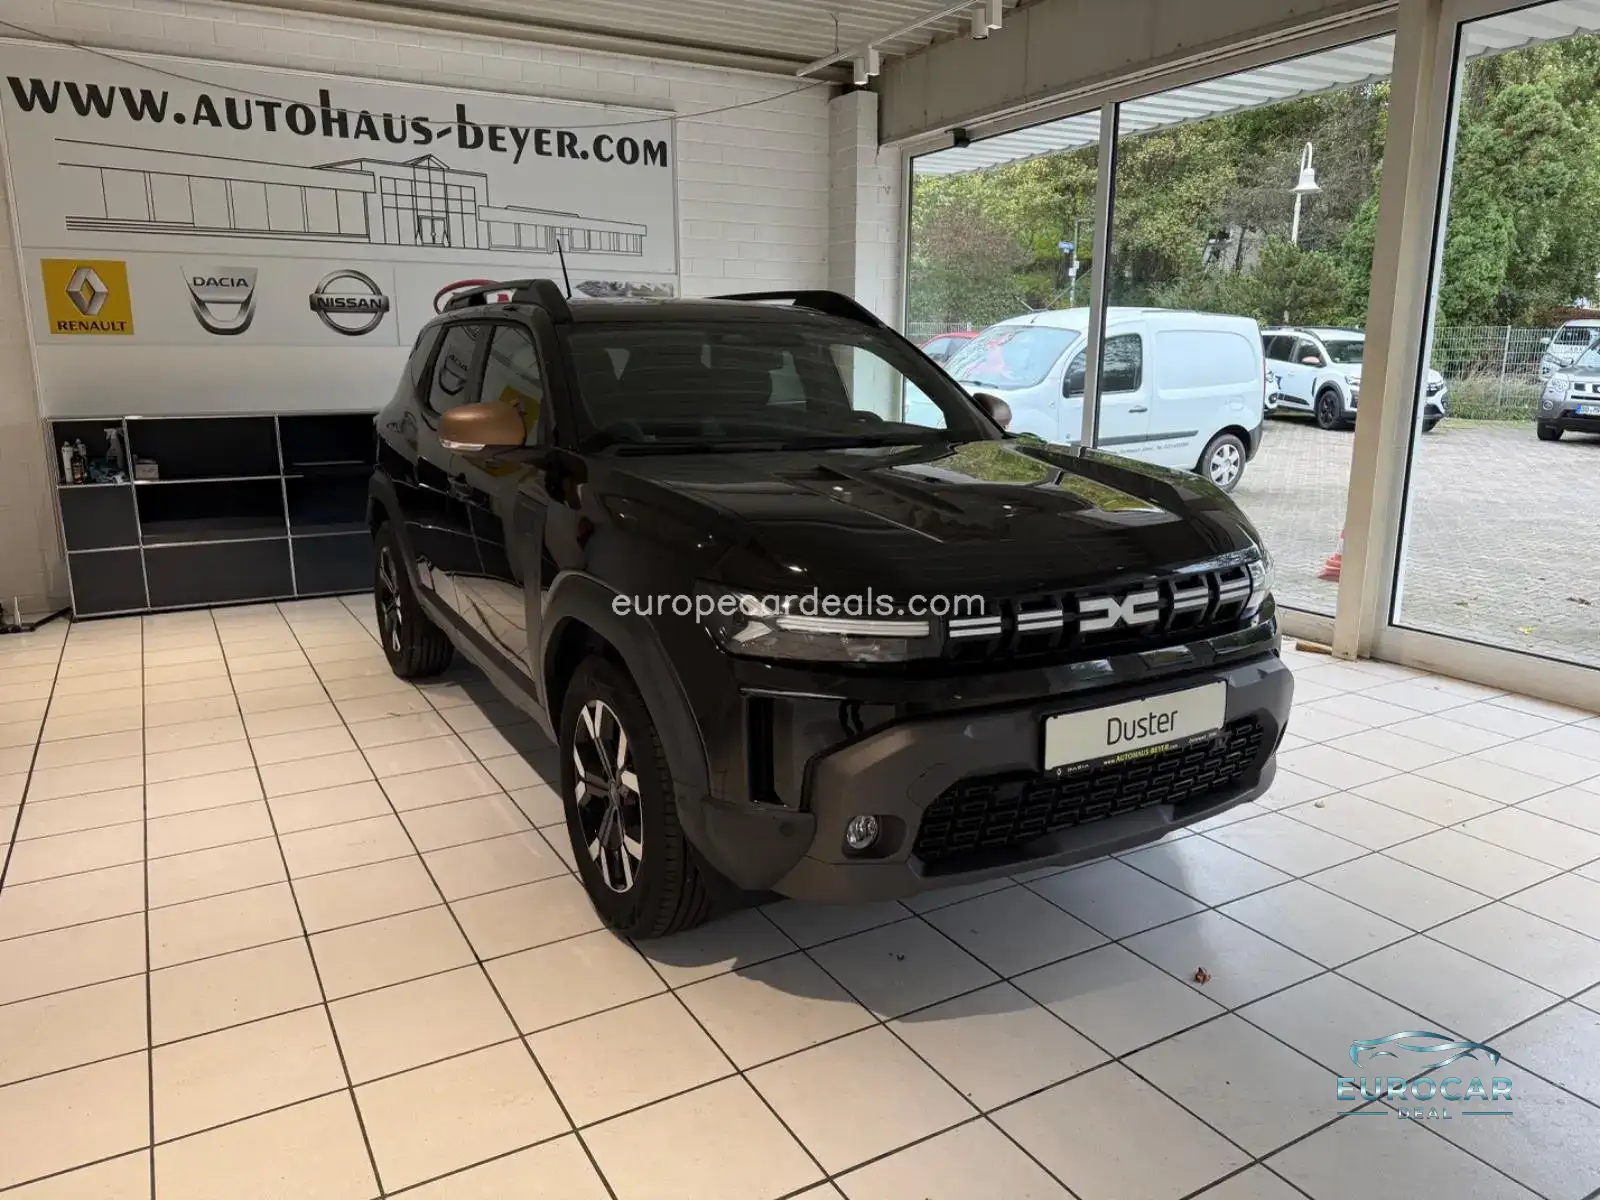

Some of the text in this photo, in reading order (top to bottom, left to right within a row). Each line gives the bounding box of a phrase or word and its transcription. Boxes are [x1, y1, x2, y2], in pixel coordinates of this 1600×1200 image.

[192, 276, 250, 289] DACIA
[316, 296, 383, 310] NISSAN
[57, 320, 127, 333] RENAULT
[1106, 710, 1179, 746] Duster
